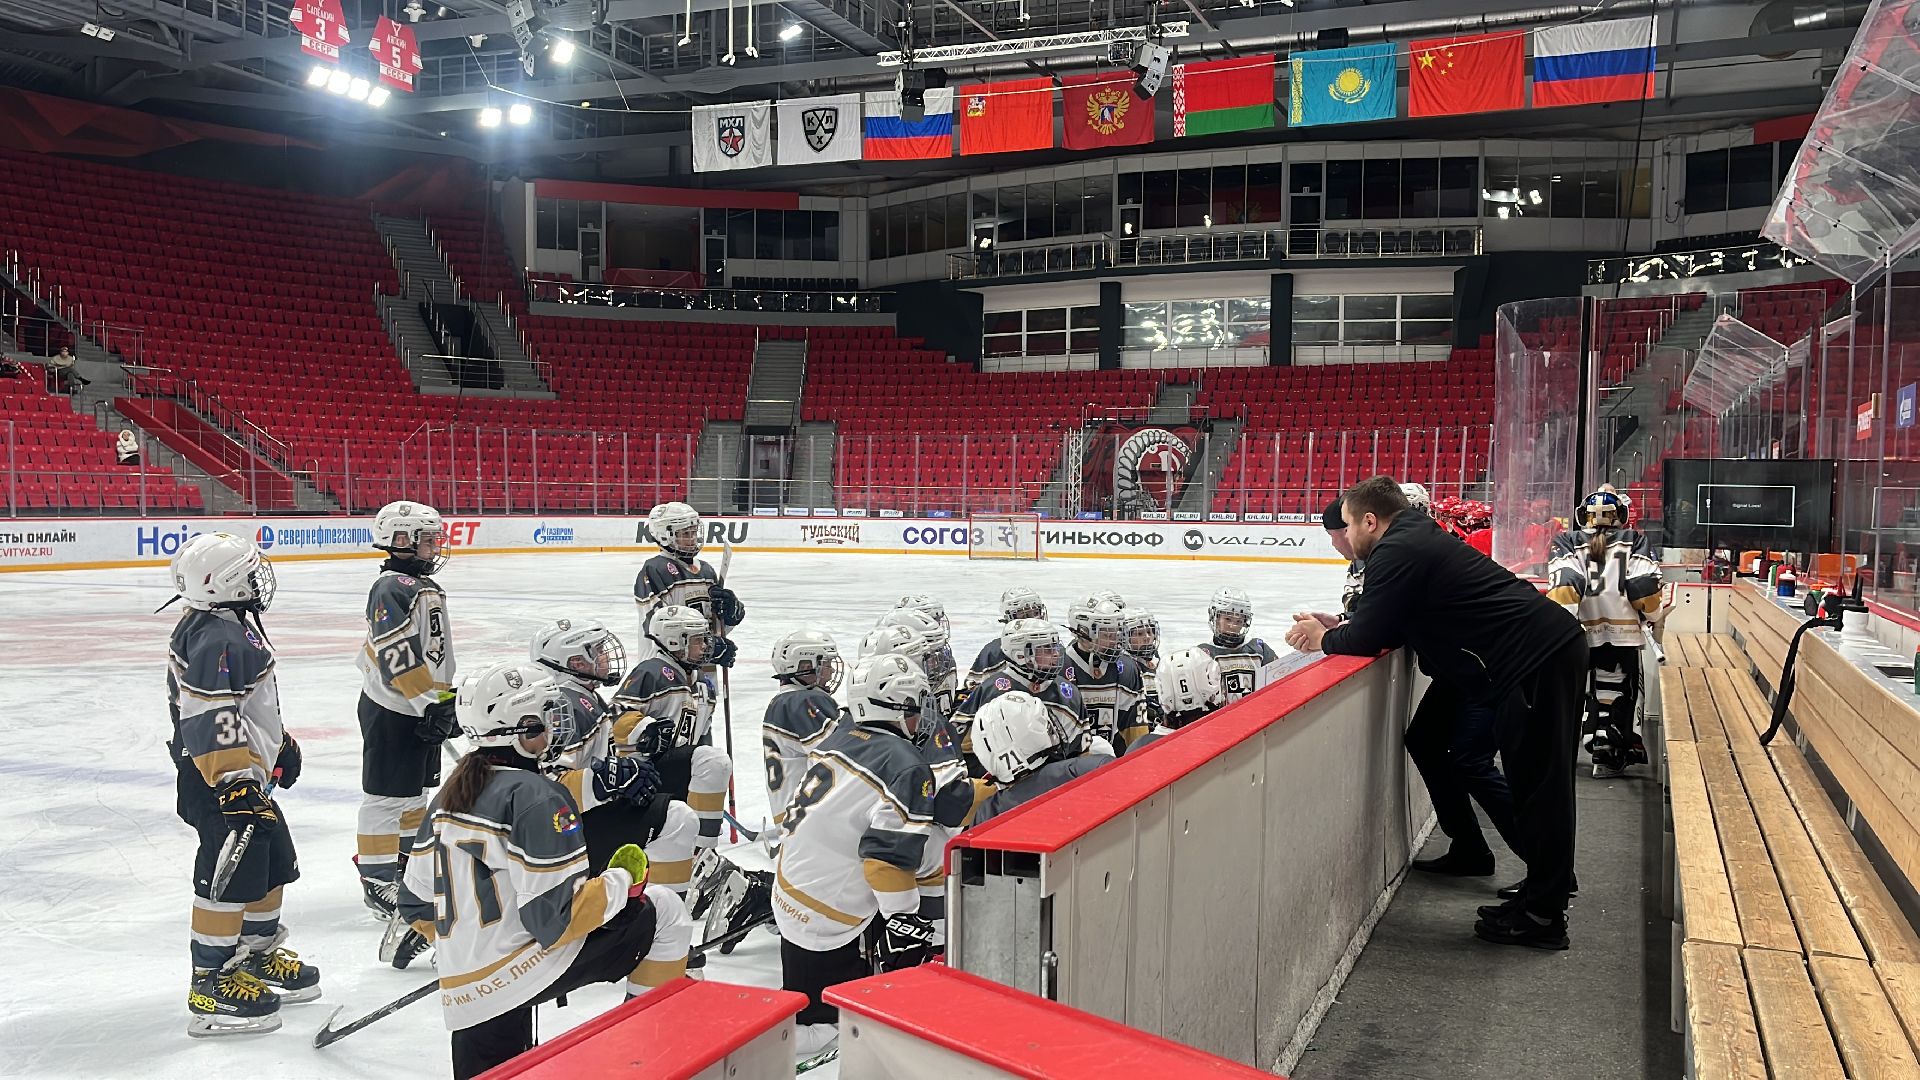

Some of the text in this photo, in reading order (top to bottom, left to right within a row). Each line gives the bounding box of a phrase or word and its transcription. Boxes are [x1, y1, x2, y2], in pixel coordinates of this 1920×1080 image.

[315, 18, 326, 41] 3
[309, 41, 332, 55] СССР
[392, 47, 402, 69] 5
[386, 67, 407, 81] СССР
[719, 117, 744, 129] МХЛ
[27, 529, 76, 543] ОНЛАЙН
[546, 527, 574, 536] ГАЗПРОМ
[800, 523, 860, 544] ТУЛЬСКИЙ
[137, 524, 201, 556] Hai
[1208, 536, 1306, 547] VALDAI
[384, 640, 418, 675] 27
[1179, 679, 1189, 694] 6
[998, 750, 1024, 771] 71
